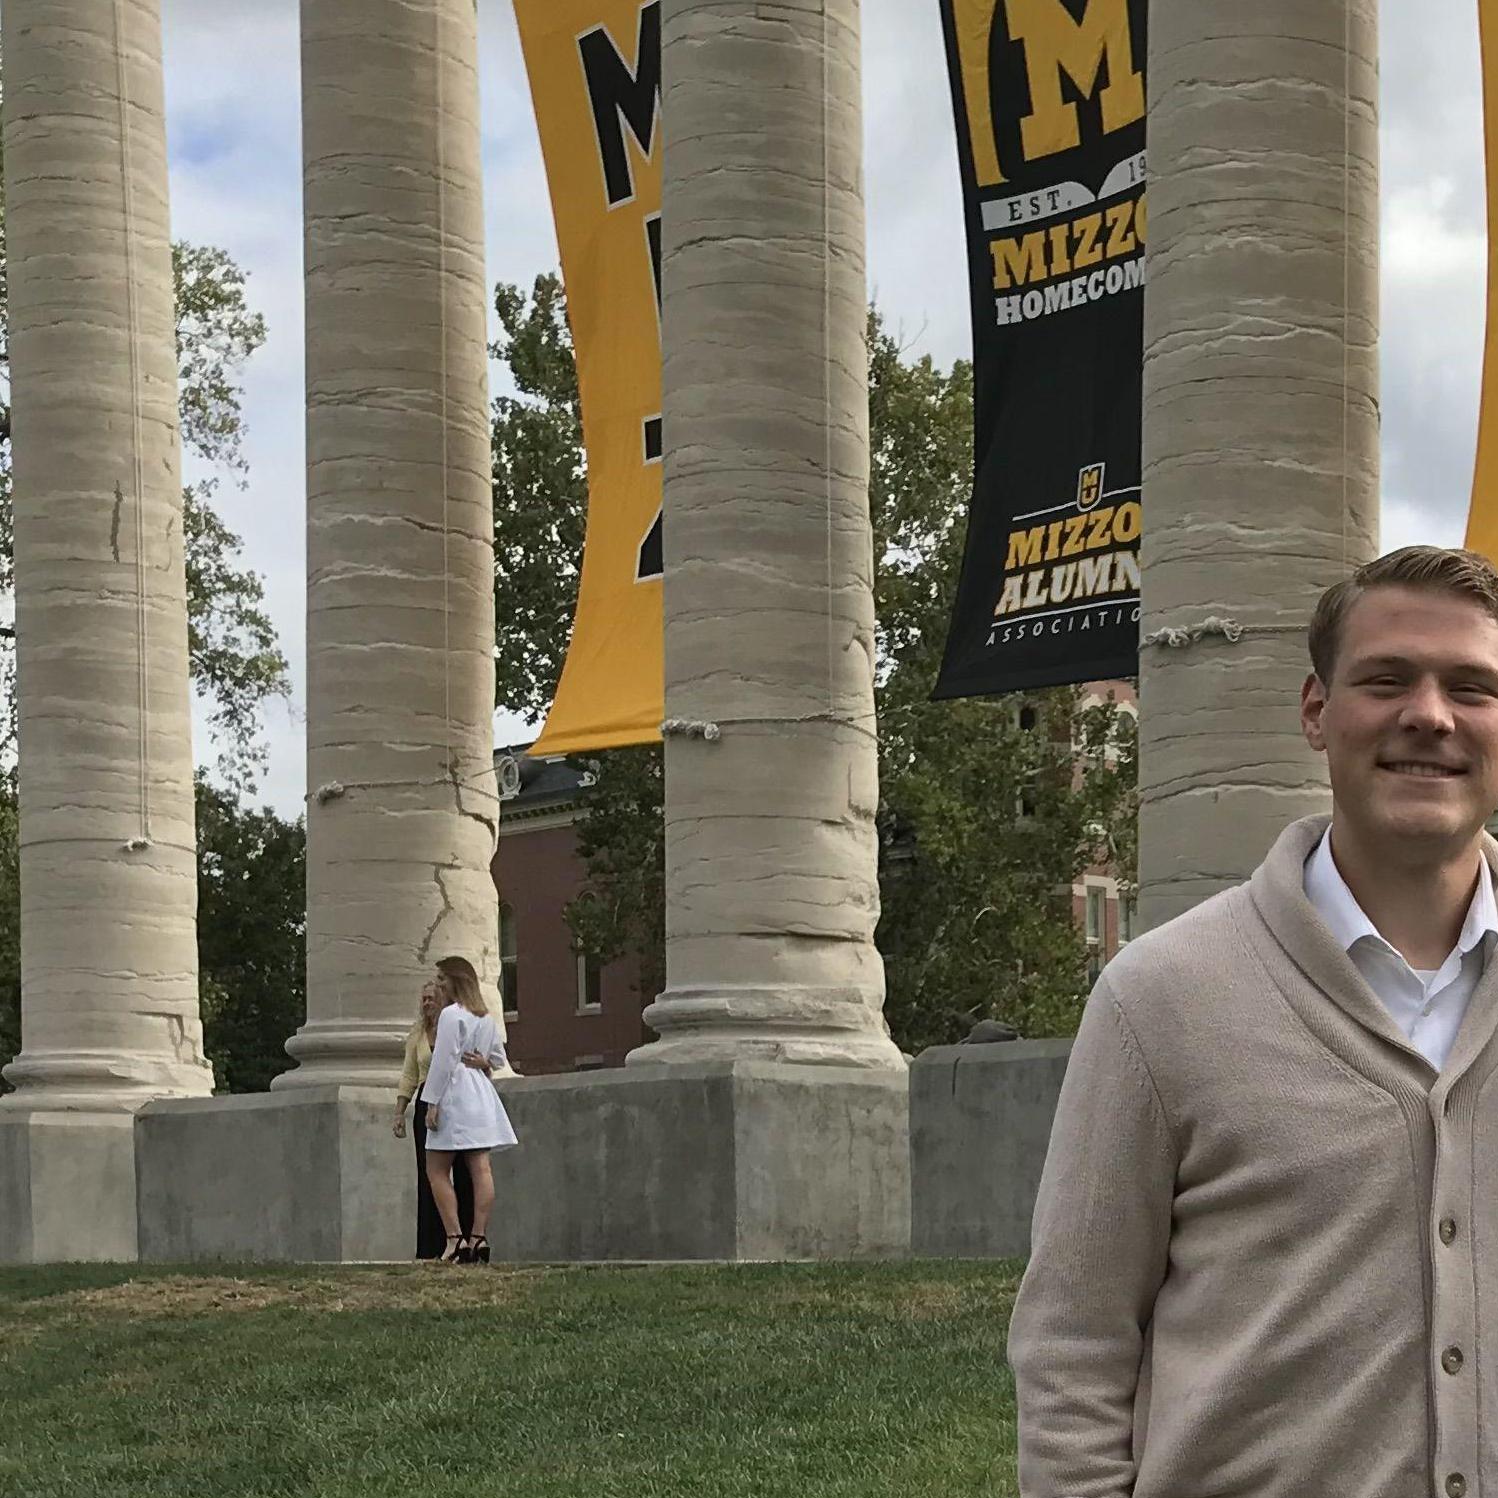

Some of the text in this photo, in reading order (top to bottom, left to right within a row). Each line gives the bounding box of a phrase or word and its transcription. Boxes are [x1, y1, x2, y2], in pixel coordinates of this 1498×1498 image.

[1009, 190, 1072, 223] EST.
[995, 256, 1146, 326] HOMECOM
[1004, 501, 1142, 571] MIZZO
[994, 550, 1141, 616] ALUMN
[985, 606, 1141, 647] ASSOCIATIO
